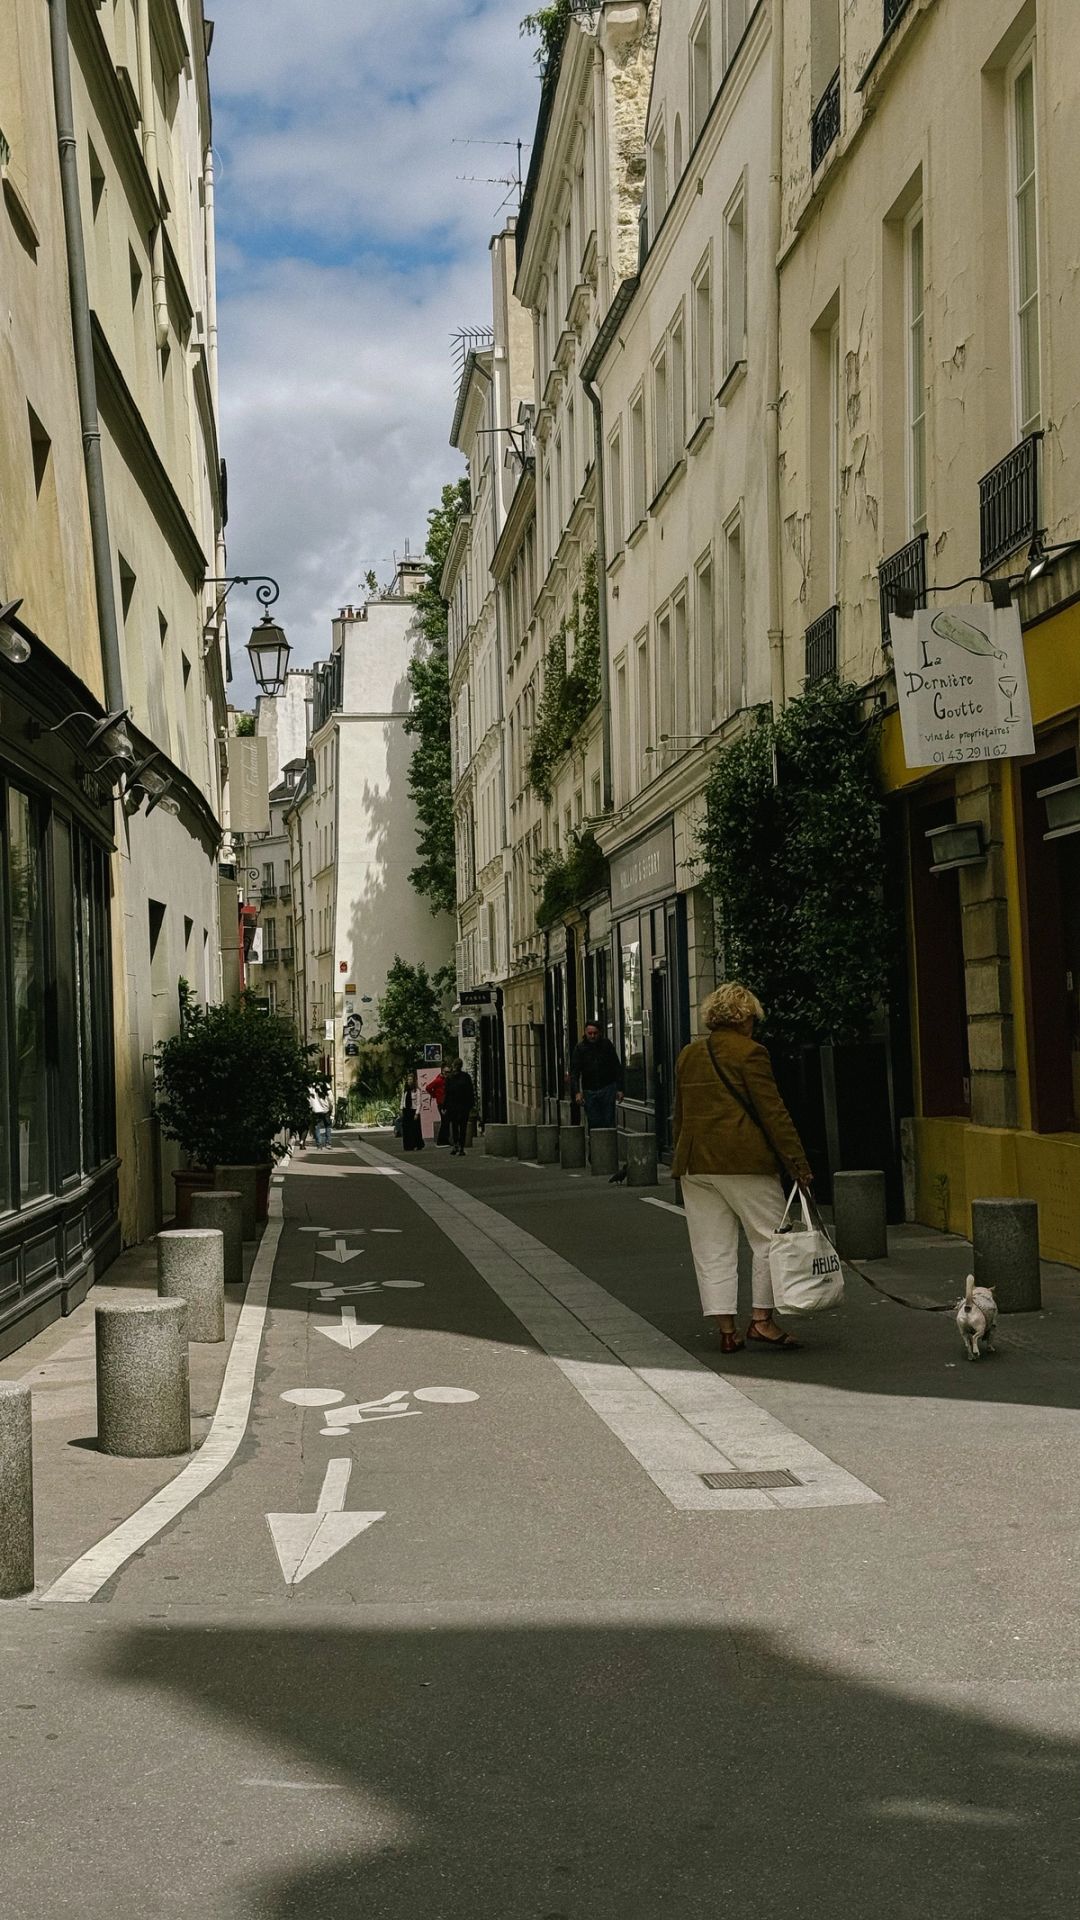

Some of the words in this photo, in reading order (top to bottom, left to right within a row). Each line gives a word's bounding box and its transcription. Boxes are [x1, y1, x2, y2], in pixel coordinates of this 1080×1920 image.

[921, 641, 941, 670] La
[903, 672, 973, 698] Dernière
[934, 693, 983, 719] Goutte
[945, 730, 954, 740] de
[933, 751, 945, 762] 01
[948, 749, 963, 760] 43
[966, 747, 981, 759] 29
[984, 746, 990, 757] 11
[993, 744, 1008, 756] 62
